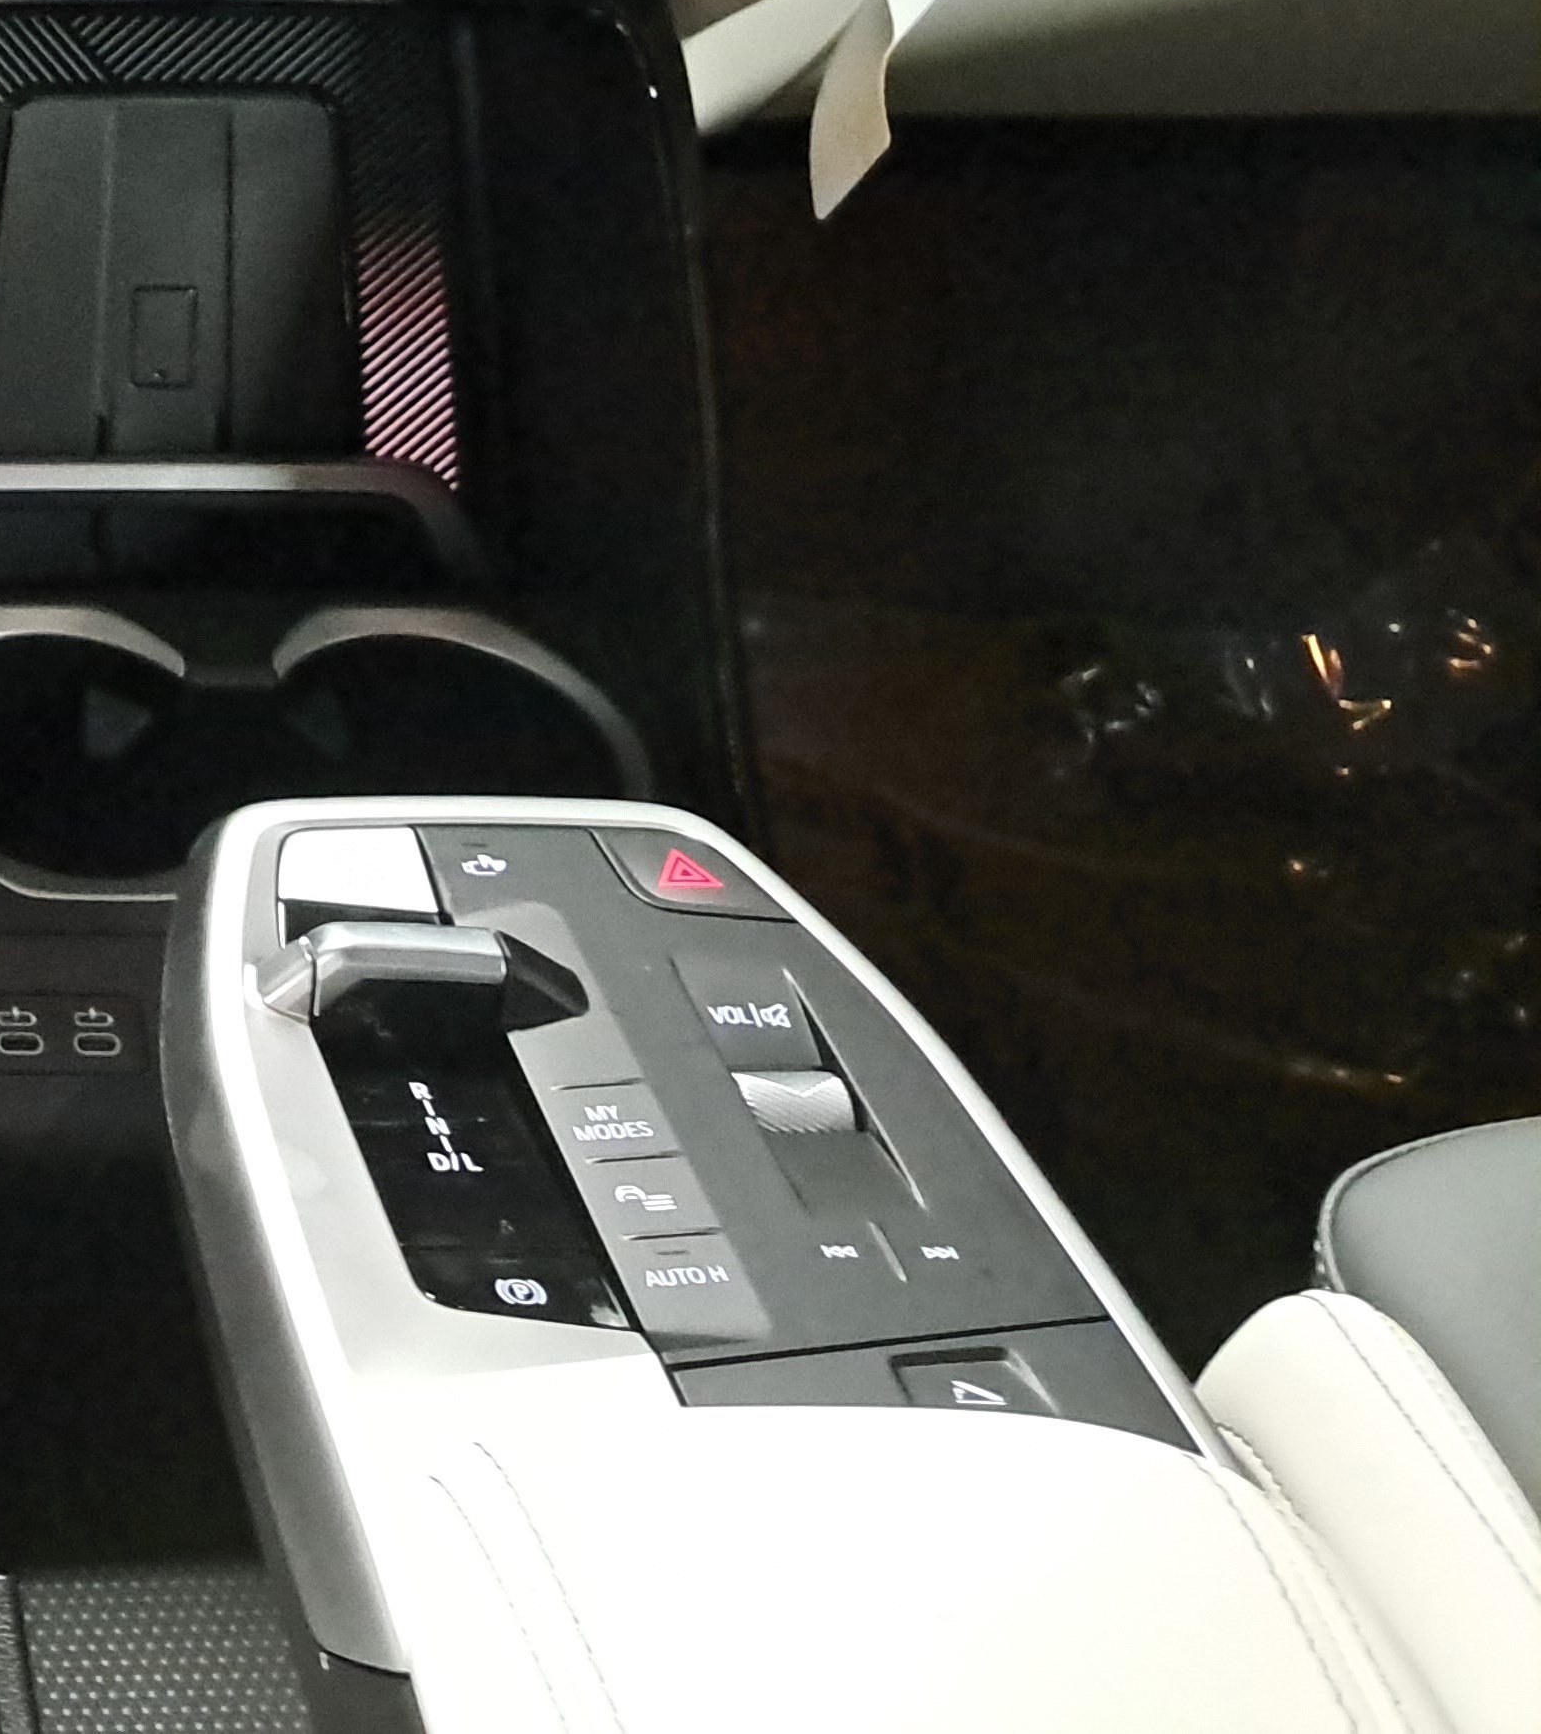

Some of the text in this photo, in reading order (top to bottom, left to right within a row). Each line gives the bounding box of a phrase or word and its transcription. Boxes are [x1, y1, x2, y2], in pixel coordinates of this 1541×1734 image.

[408, 1081, 433, 1100] R
[584, 1104, 620, 1121] MY
[425, 1117, 451, 1135] N
[573, 1120, 655, 1141] MODES
[645, 1266, 731, 1288] AUTO H
